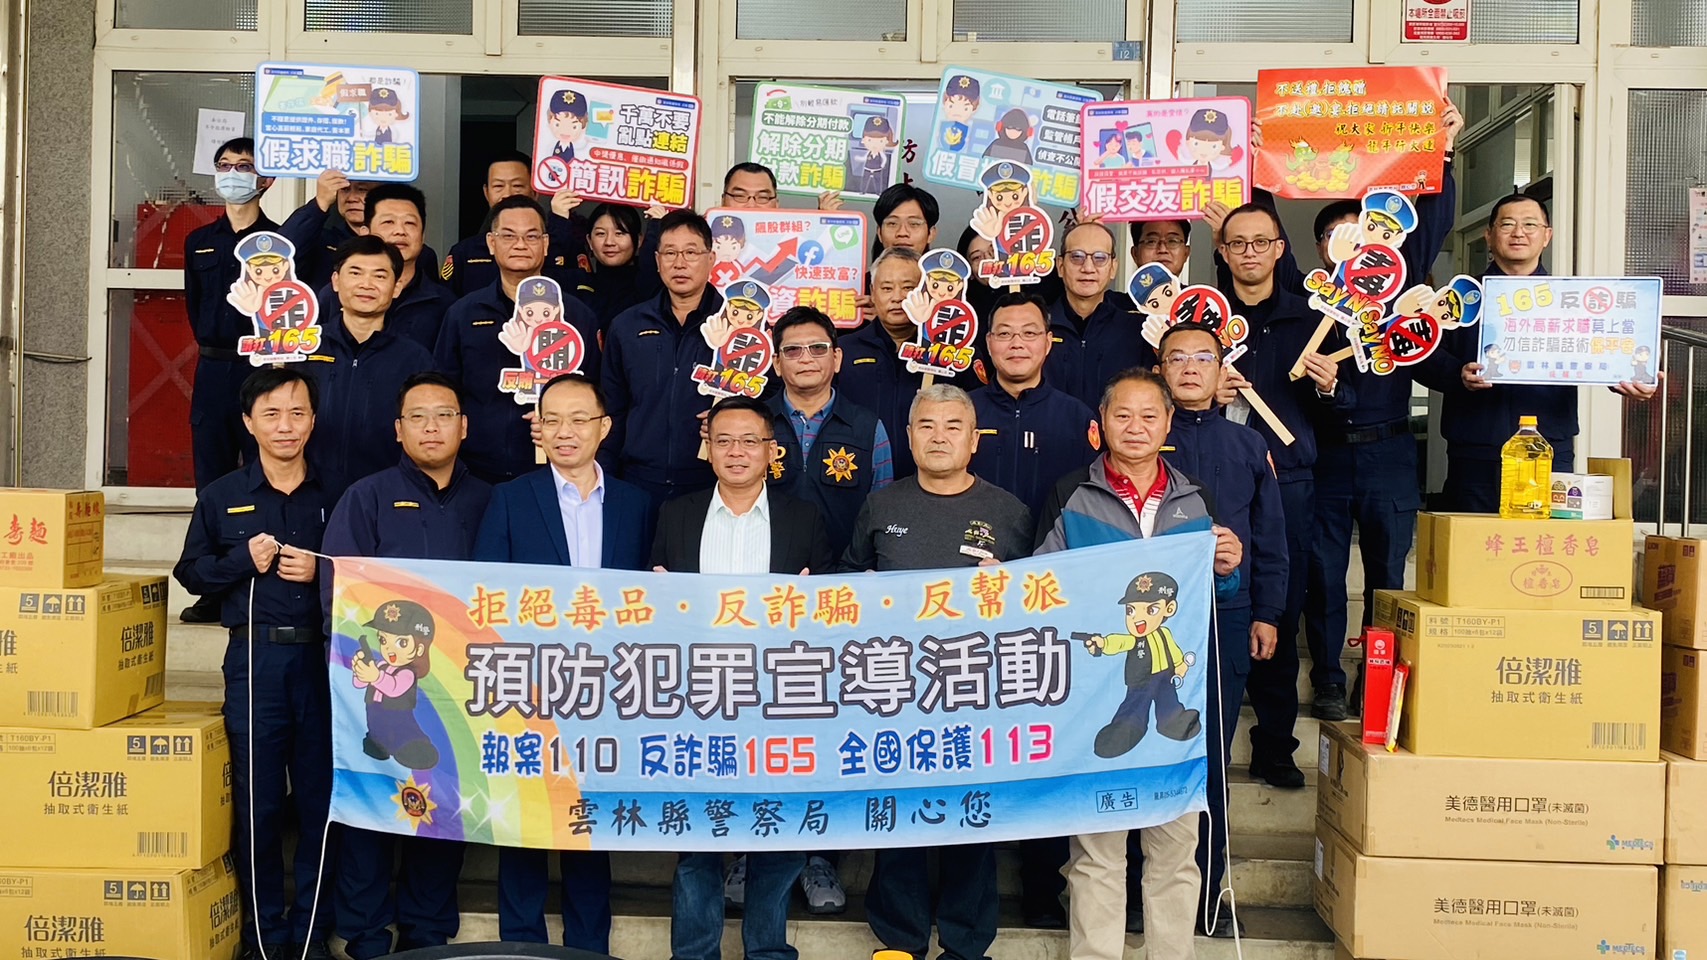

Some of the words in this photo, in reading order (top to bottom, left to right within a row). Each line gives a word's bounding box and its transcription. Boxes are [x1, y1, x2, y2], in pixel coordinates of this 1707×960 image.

[619, 104, 690, 131] 千萬不要
[763, 112, 850, 131] 不能解除分期付款
[617, 125, 689, 153] 亂點連結
[756, 130, 848, 161] 解除分期
[261, 137, 413, 174] 假求職詐騙
[569, 157, 687, 205] 簡訊詐騙
[1086, 177, 1244, 213] 假交友詐騙
[1496, 282, 1553, 316] 165
[1504, 318, 1635, 334] 海外高薪求職莫上當
[1485, 533, 1600, 557] 蜂王檀香皂
[465, 627, 1071, 719] 預防犯罪宣導活動
[1495, 656, 1583, 686] 倍潔雅
[1491, 690, 1583, 705] 抽取式衛生紙
[481, 731, 619, 777] 報案110
[640, 732, 816, 778] 反詐騙165
[838, 724, 1054, 777] 全國保護113
[48, 770, 128, 798] 倍潔雅
[44, 803, 129, 815] 抽取式衛生紙
[568, 798, 829, 838] 雲林縣警察局
[865, 791, 992, 833] 關心您
[1100, 792, 1135, 810] 廣告
[1445, 795, 1589, 814] 美德醫用口罩(未滅菌)
[1433, 897, 1580, 917] 美德醫用口罩(未滅菌)
[24, 915, 105, 943] 倍潔雅
